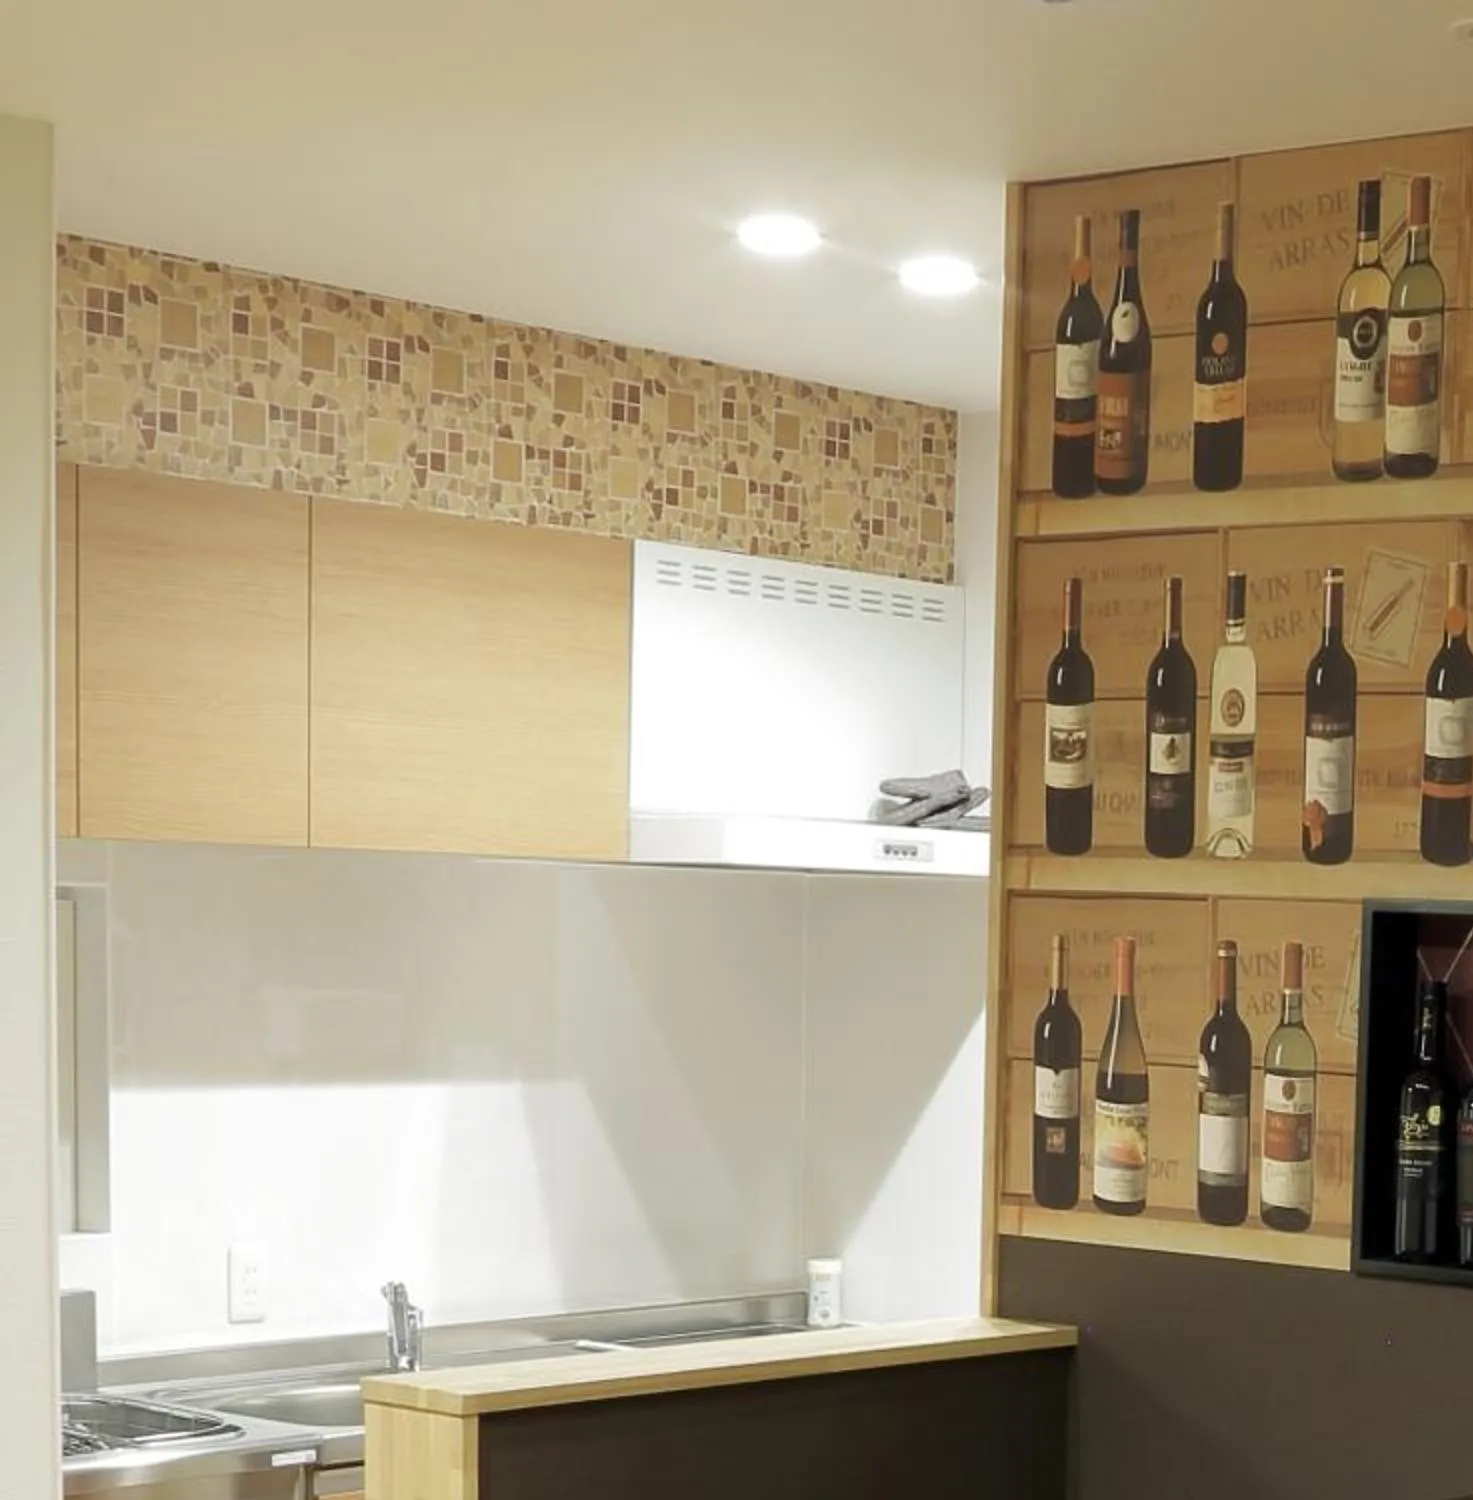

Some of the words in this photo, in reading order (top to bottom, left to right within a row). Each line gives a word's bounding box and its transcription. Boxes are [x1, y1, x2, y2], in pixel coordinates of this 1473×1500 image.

[1259, 198, 1304, 232] VIN
[1317, 187, 1350, 218] DE
[1268, 226, 1352, 274] ARRAS
[1249, 576, 1291, 603] VIN
[1254, 606, 1323, 643] ARRA
